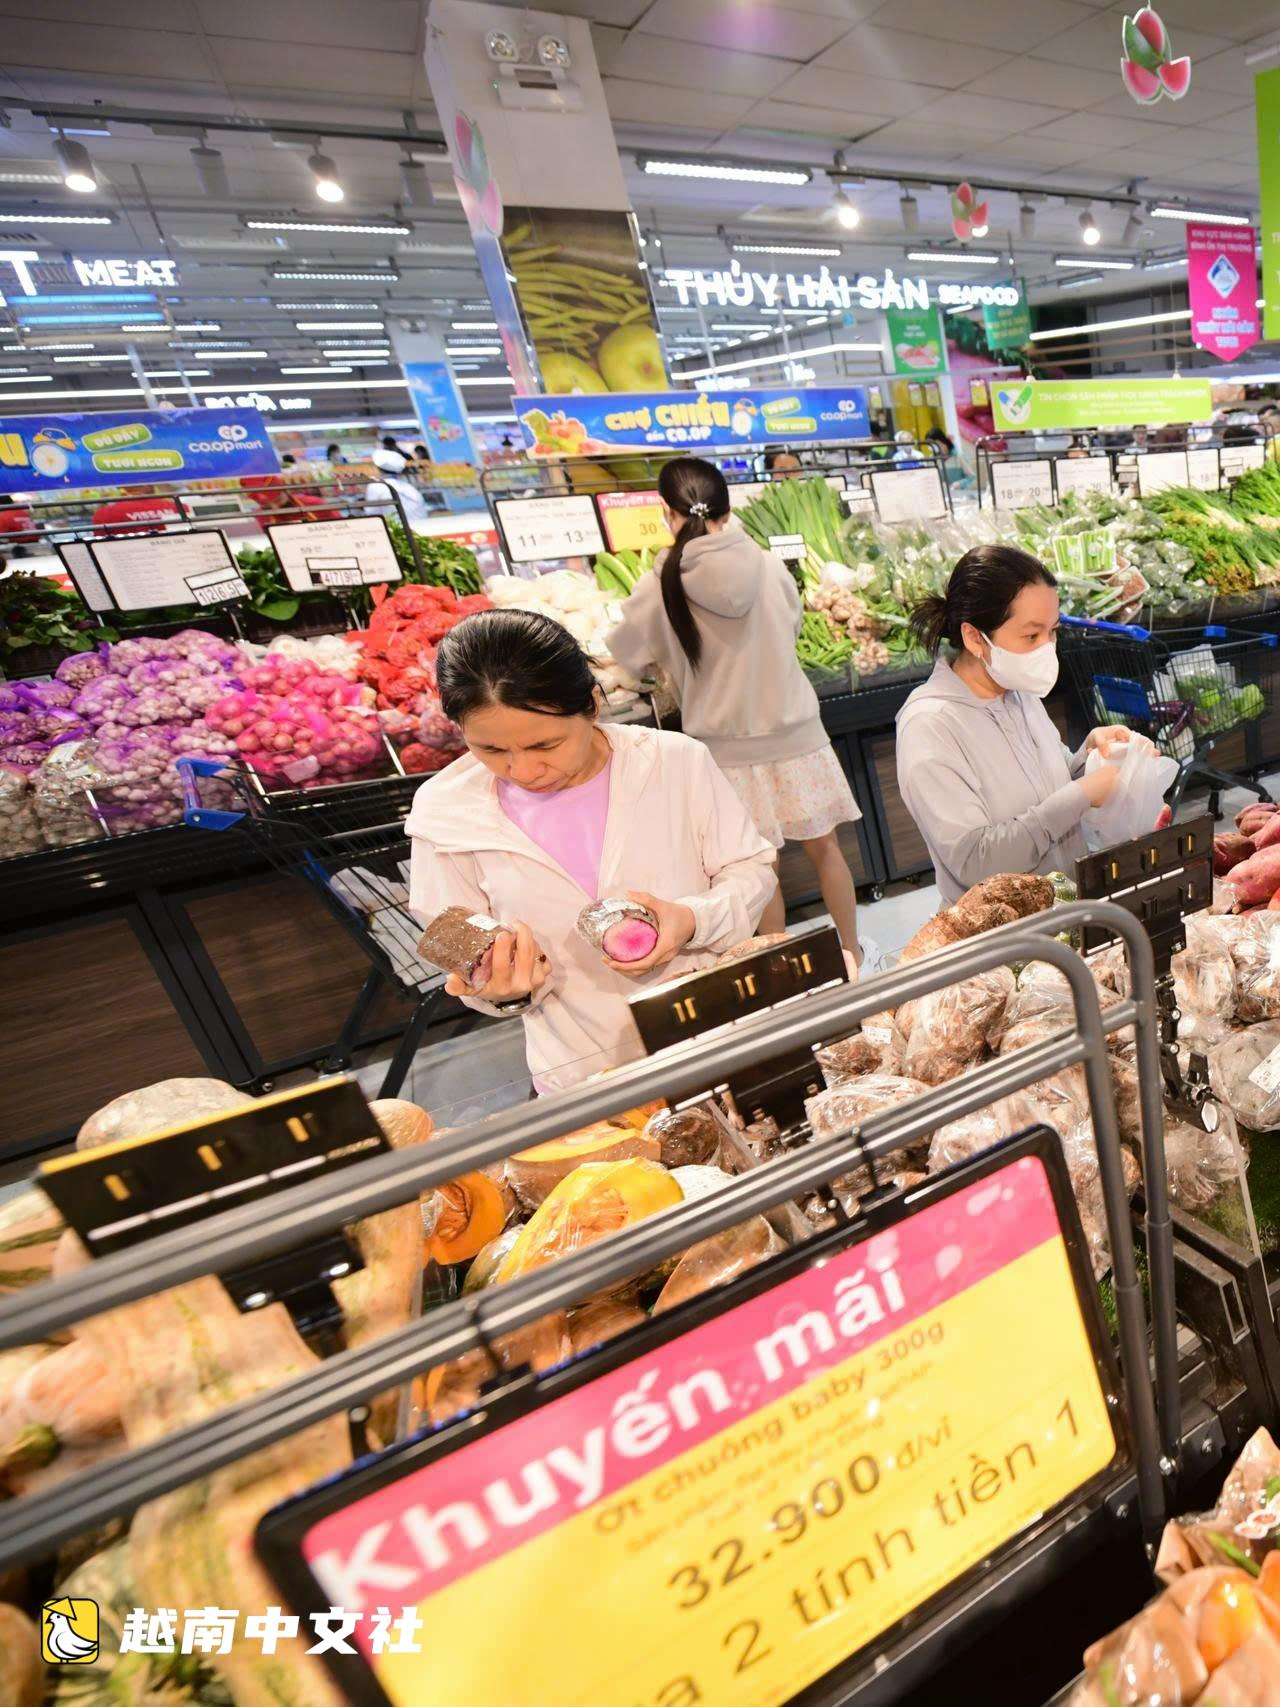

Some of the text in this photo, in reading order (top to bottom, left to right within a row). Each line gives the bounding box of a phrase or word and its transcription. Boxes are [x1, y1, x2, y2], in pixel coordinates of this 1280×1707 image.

[0, 250, 179, 306] T MEAT
[673, 259, 779, 308] THỦY
[786, 265, 851, 308] HẢI
[858, 268, 930, 311] SẢN
[518, 533, 537, 548] 11
[564, 529, 584, 544] 13
[638, 522, 658, 536] 30
[791, 1366, 867, 1422] baby
[879, 1319, 946, 1371] 300g
[312, 1368, 736, 1612] Khuyến
[754, 1264, 905, 1383] mãi
[667, 1452, 882, 1612] 32.900
[722, 1618, 774, 1678] 2
[790, 1523, 916, 1628] tính
[932, 1438, 1038, 1529] tiền
[1056, 1398, 1083, 1440] 1
